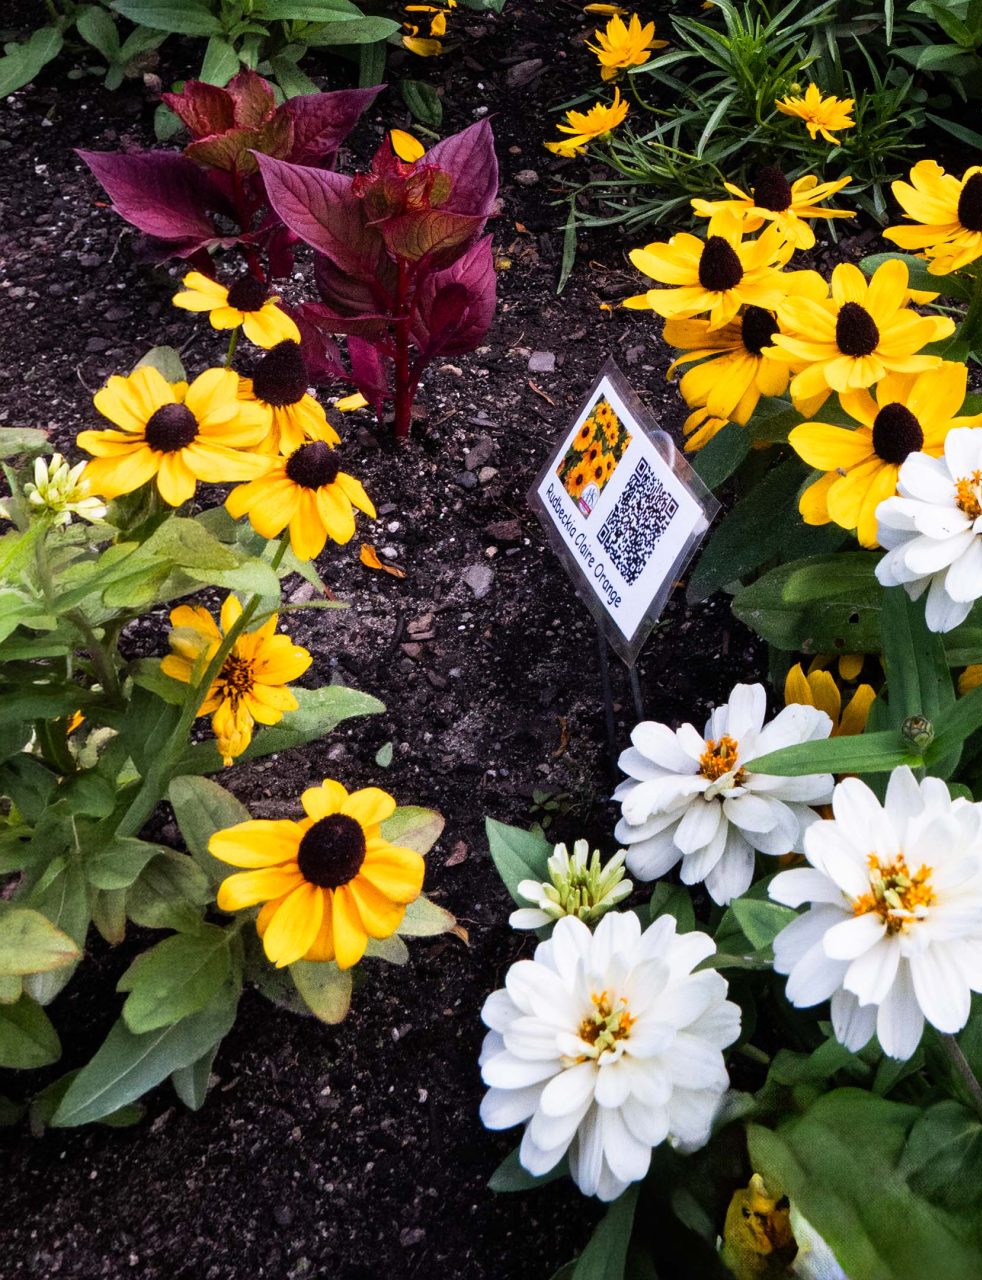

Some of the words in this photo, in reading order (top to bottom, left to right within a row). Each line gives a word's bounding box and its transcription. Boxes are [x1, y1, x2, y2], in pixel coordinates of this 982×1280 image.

[546, 482, 577, 537] Rudbeckia
[575, 533, 595, 568] Claire
[594, 563, 622, 608] Orange
